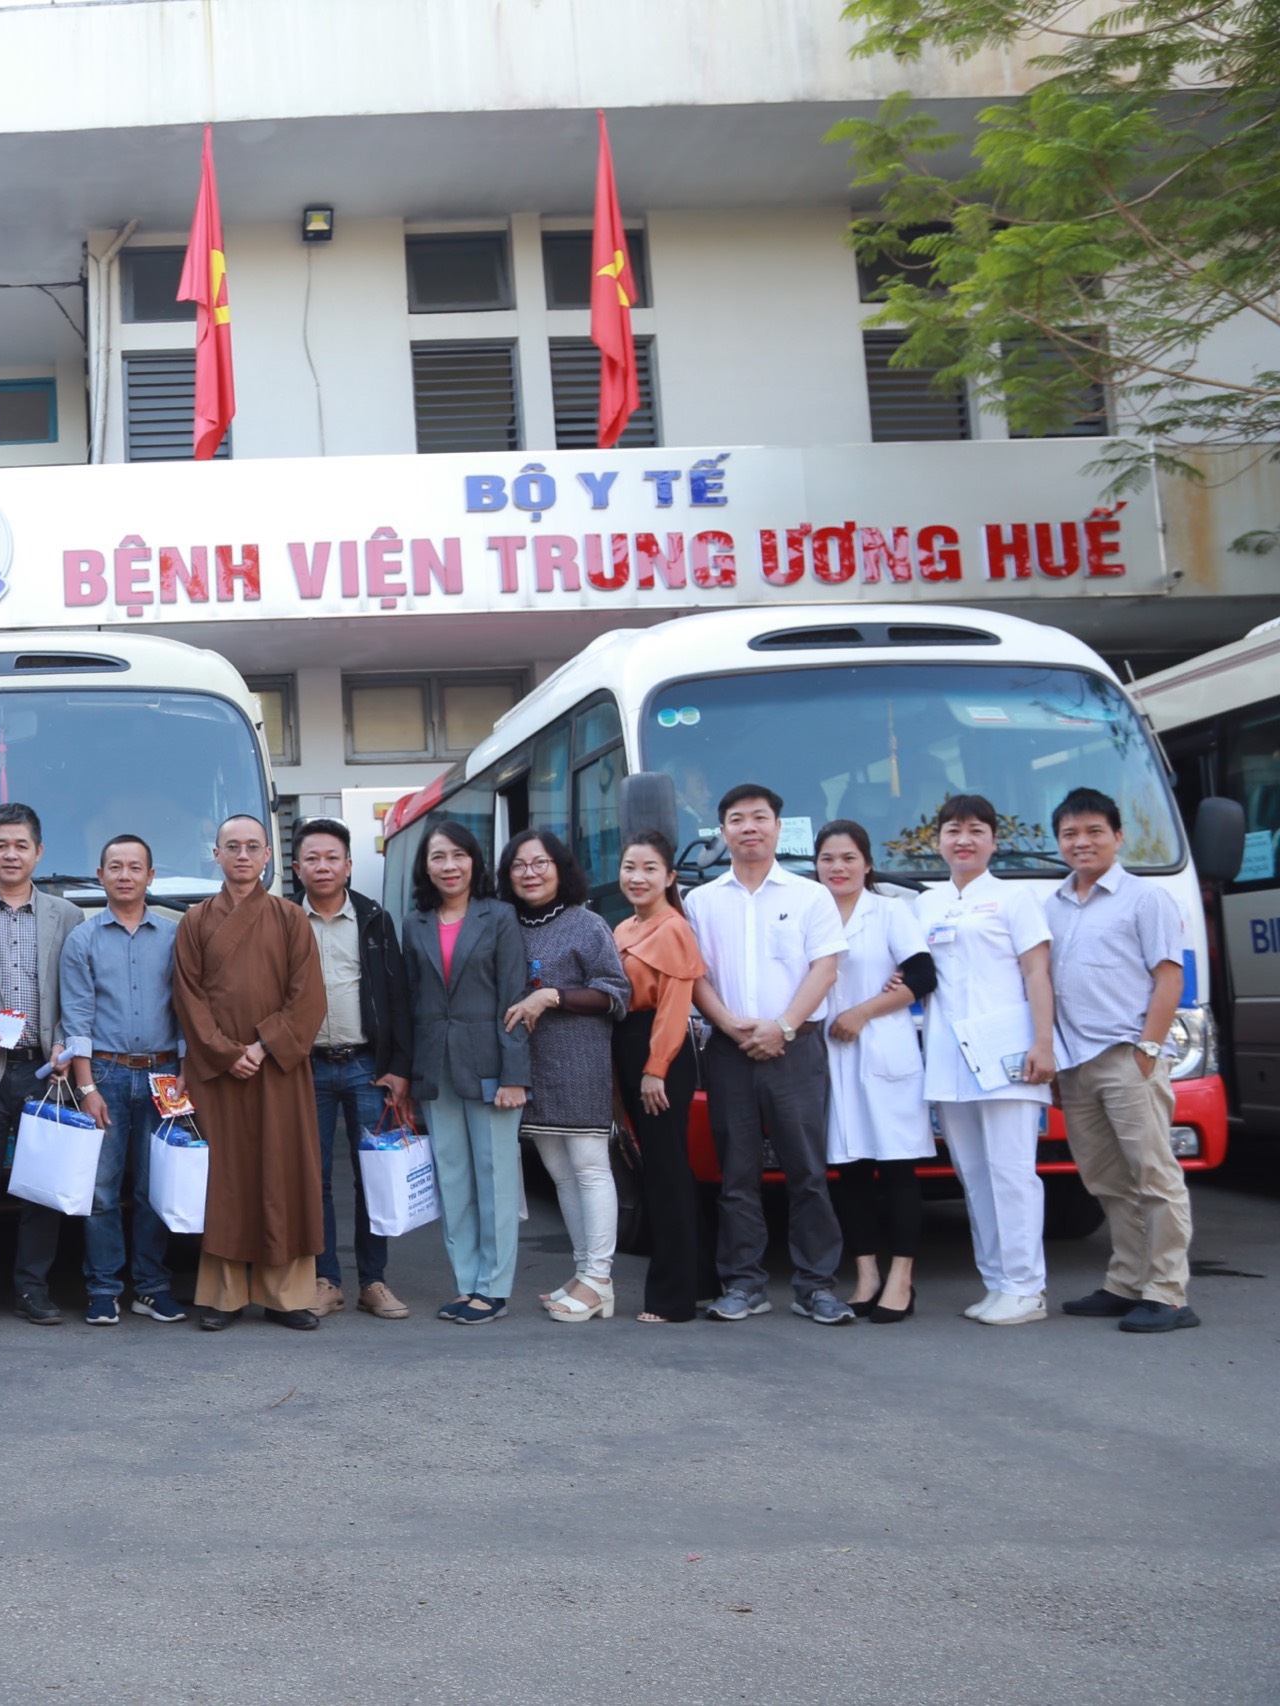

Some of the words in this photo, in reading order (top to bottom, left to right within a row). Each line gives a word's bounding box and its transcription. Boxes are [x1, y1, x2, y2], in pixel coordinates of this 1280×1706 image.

[465, 462, 557, 522] BỘ
[576, 471, 619, 509] Y
[643, 453, 731, 508] TẾ
[62, 534, 261, 617] BỆNH
[287, 526, 463, 610] VIỆN
[487, 531, 737, 593] TRUNG
[758, 521, 963, 587] ƯƠNG
[981, 501, 1129, 581] HUẾ
